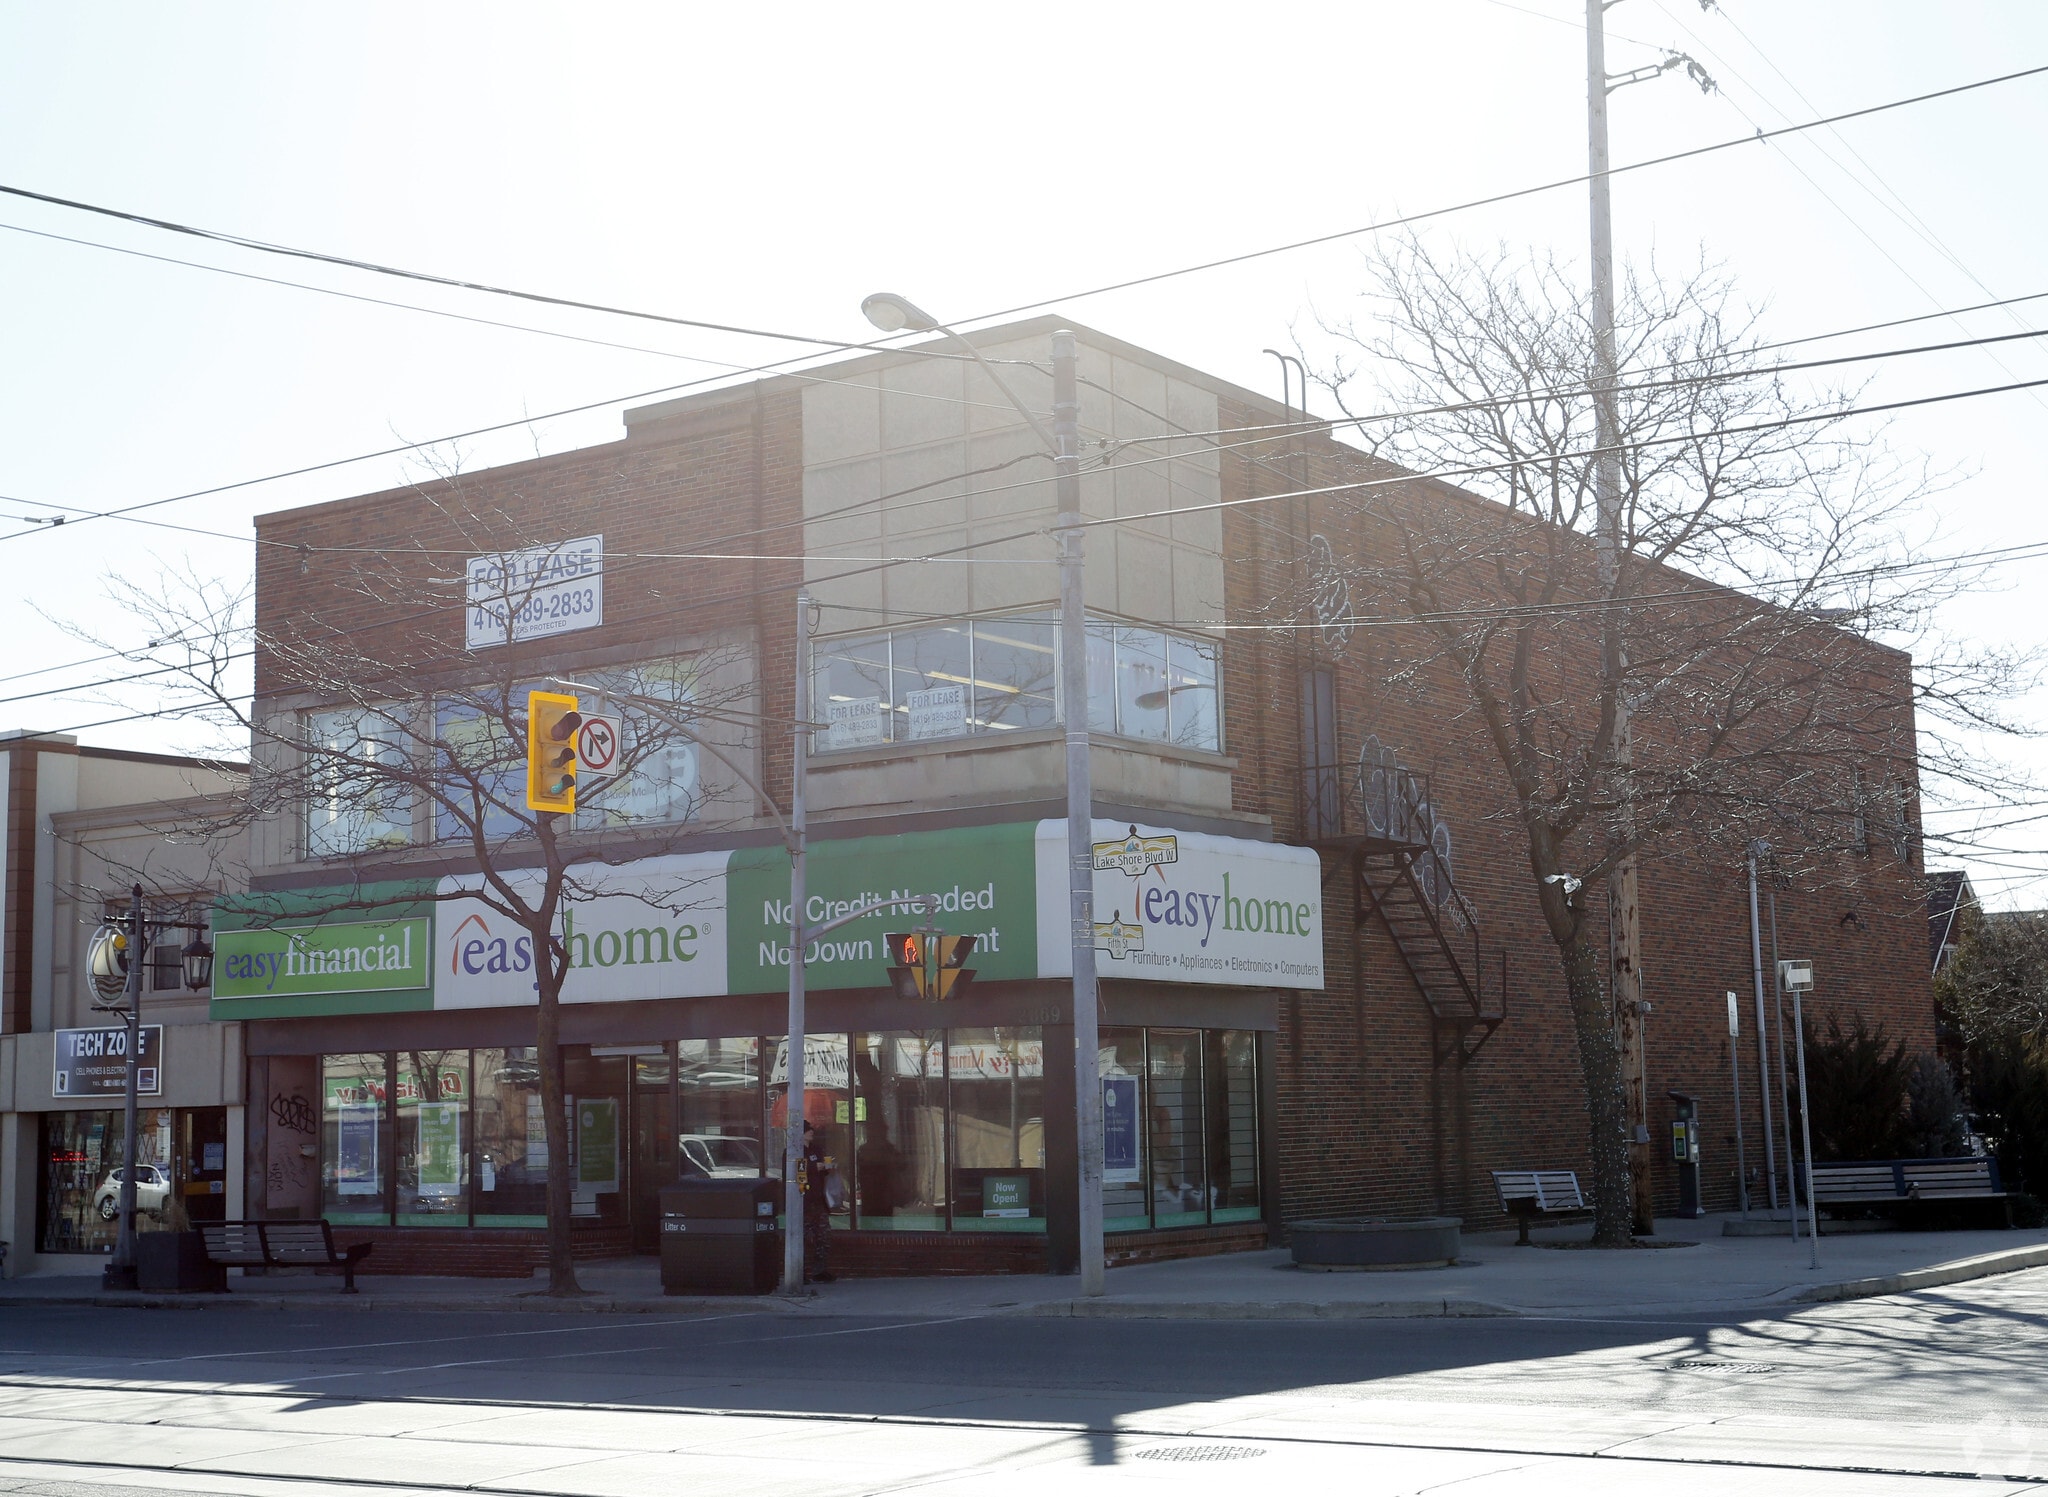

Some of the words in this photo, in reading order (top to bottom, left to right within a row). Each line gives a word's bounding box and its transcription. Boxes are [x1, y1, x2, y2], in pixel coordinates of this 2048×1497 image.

[474, 562, 518, 593] FOR
[524, 548, 593, 585] LEASE
[473, 588, 594, 630] 416-489-2833
[499, 623, 529, 637] BRKERS
[529, 619, 567, 632] PROTECTED
[911, 695, 930, 708] FOR
[932, 690, 960, 705] LEASE
[830, 706, 847, 720] FOR
[850, 702, 876, 717] LEASE
[1096, 857, 1115, 868] Lake
[1118, 853, 1143, 866] Shore
[1145, 849, 1164, 862] Blvd
[1166, 848, 1174, 861] W
[806, 892, 882, 921] Credit
[1145, 872, 1311, 948] easyhome
[462, 908, 698, 990] eashome
[759, 941, 791, 967] No
[803, 934, 873, 964] Down
[1107, 938, 1121, 948] Fifth
[1123, 938, 1128, 948] St
[1132, 951, 1170, 967] Furniture
[1179, 953, 1223, 971] Appliances
[1231, 957, 1273, 973] Electronics
[1280, 961, 1319, 977] Computers
[69, 1032, 105, 1057] TECH
[107, 1031, 146, 1055] ZOE
[996, 1183, 1015, 1191] Now
[993, 1193, 1018, 1203] Open!
[665, 1222, 679, 1231] Litter
[756, 1223, 768, 1231] Litter
